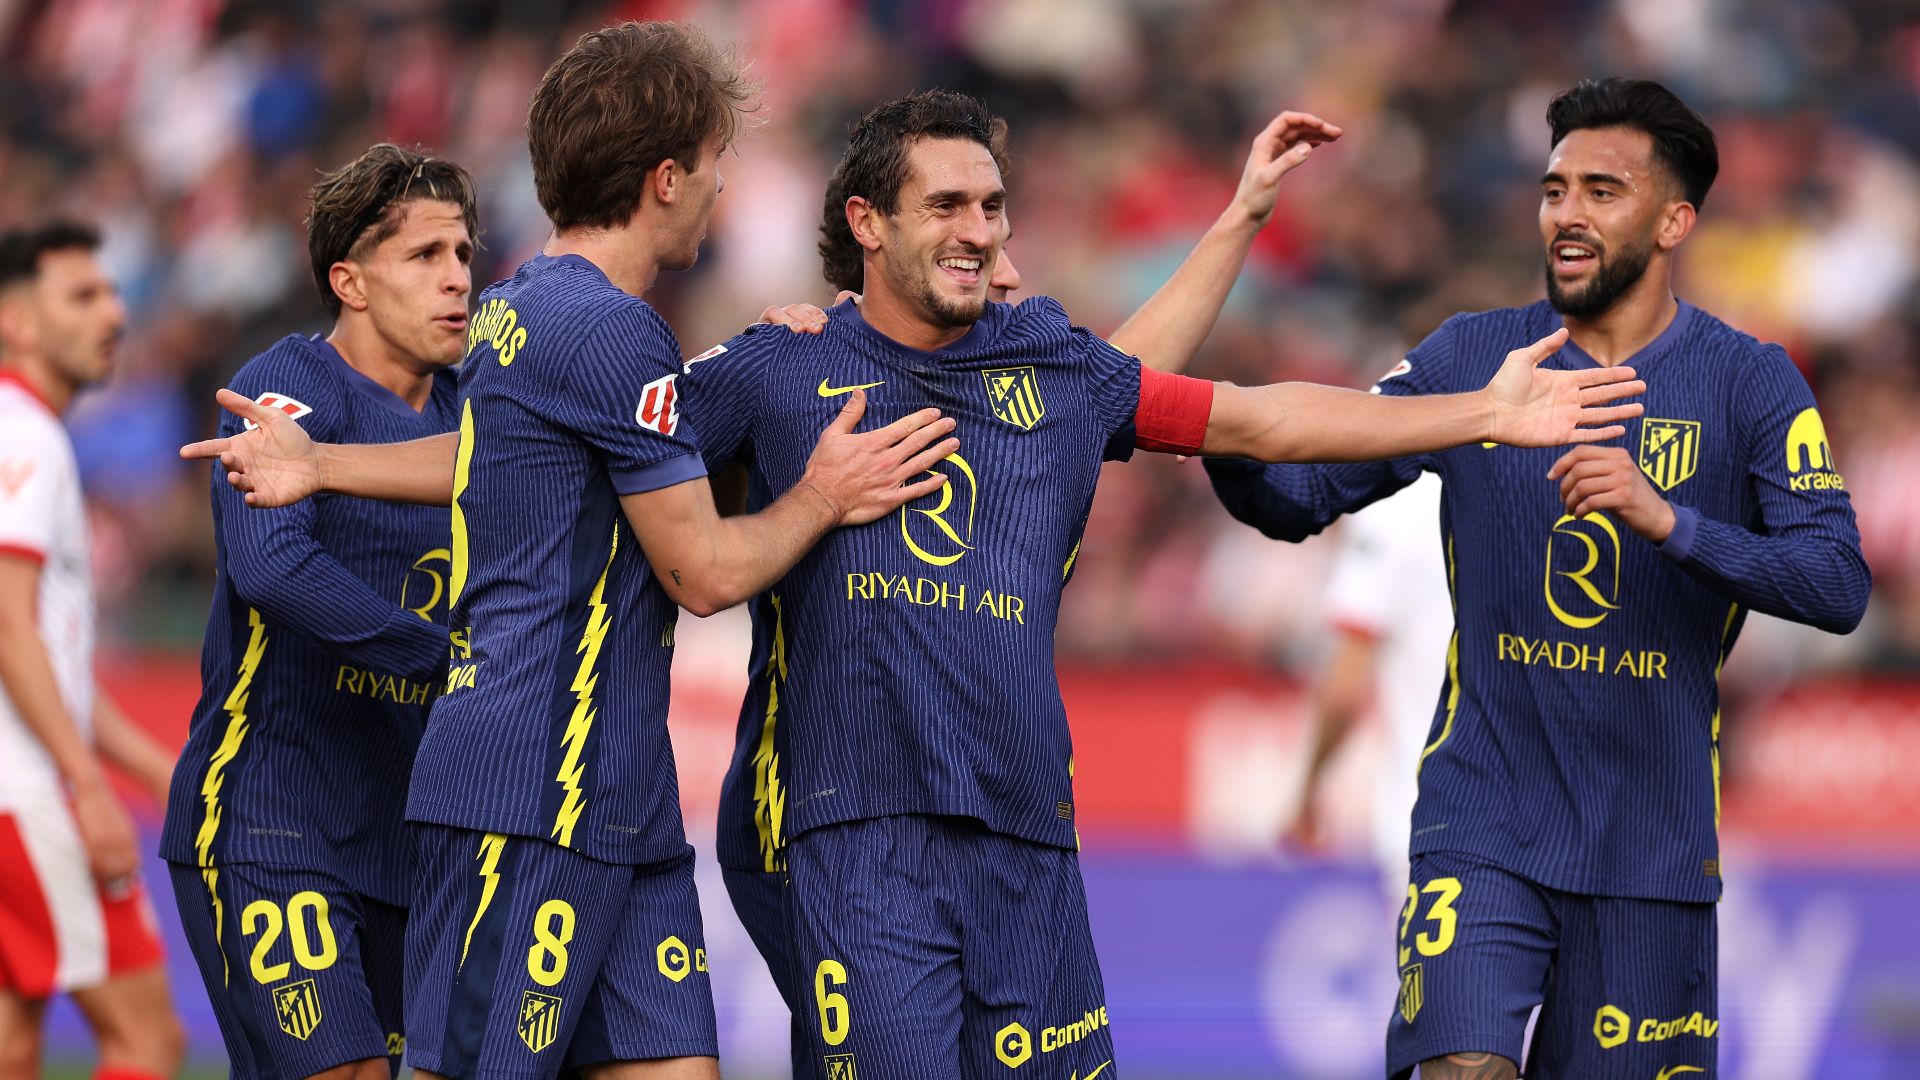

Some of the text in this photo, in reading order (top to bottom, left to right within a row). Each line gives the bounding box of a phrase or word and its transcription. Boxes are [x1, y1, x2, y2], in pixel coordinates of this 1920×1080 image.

[467, 298, 527, 366] BARRIOS
[847, 572, 1025, 625] RIYADH AIR
[336, 665, 431, 705] RIYADH
[1498, 633, 1667, 679] RIYADH AIR
[241, 890, 338, 985] 20
[528, 899, 575, 987] 8
[1399, 877, 1462, 967] 23
[815, 959, 850, 1046] 6
[1636, 1011, 1719, 1042] ComAv
